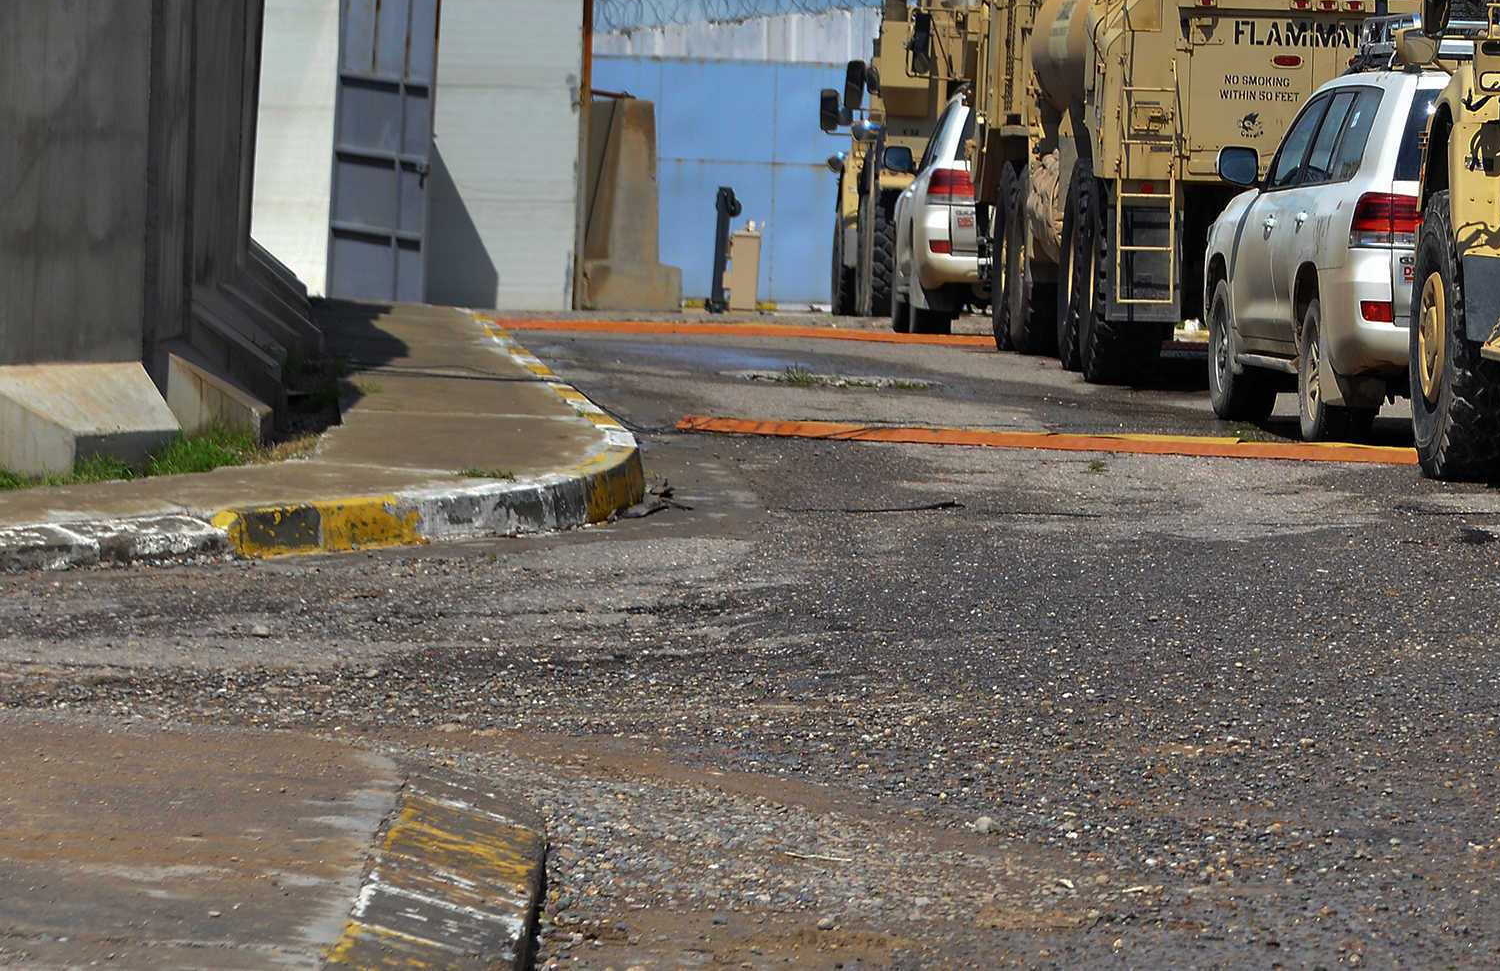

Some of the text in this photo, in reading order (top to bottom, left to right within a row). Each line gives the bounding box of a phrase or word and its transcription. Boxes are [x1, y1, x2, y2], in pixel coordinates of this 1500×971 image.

[1224, 75, 1290, 88] NO SMOKING
[1220, 89, 1300, 103] WITHIN 50 FEET
